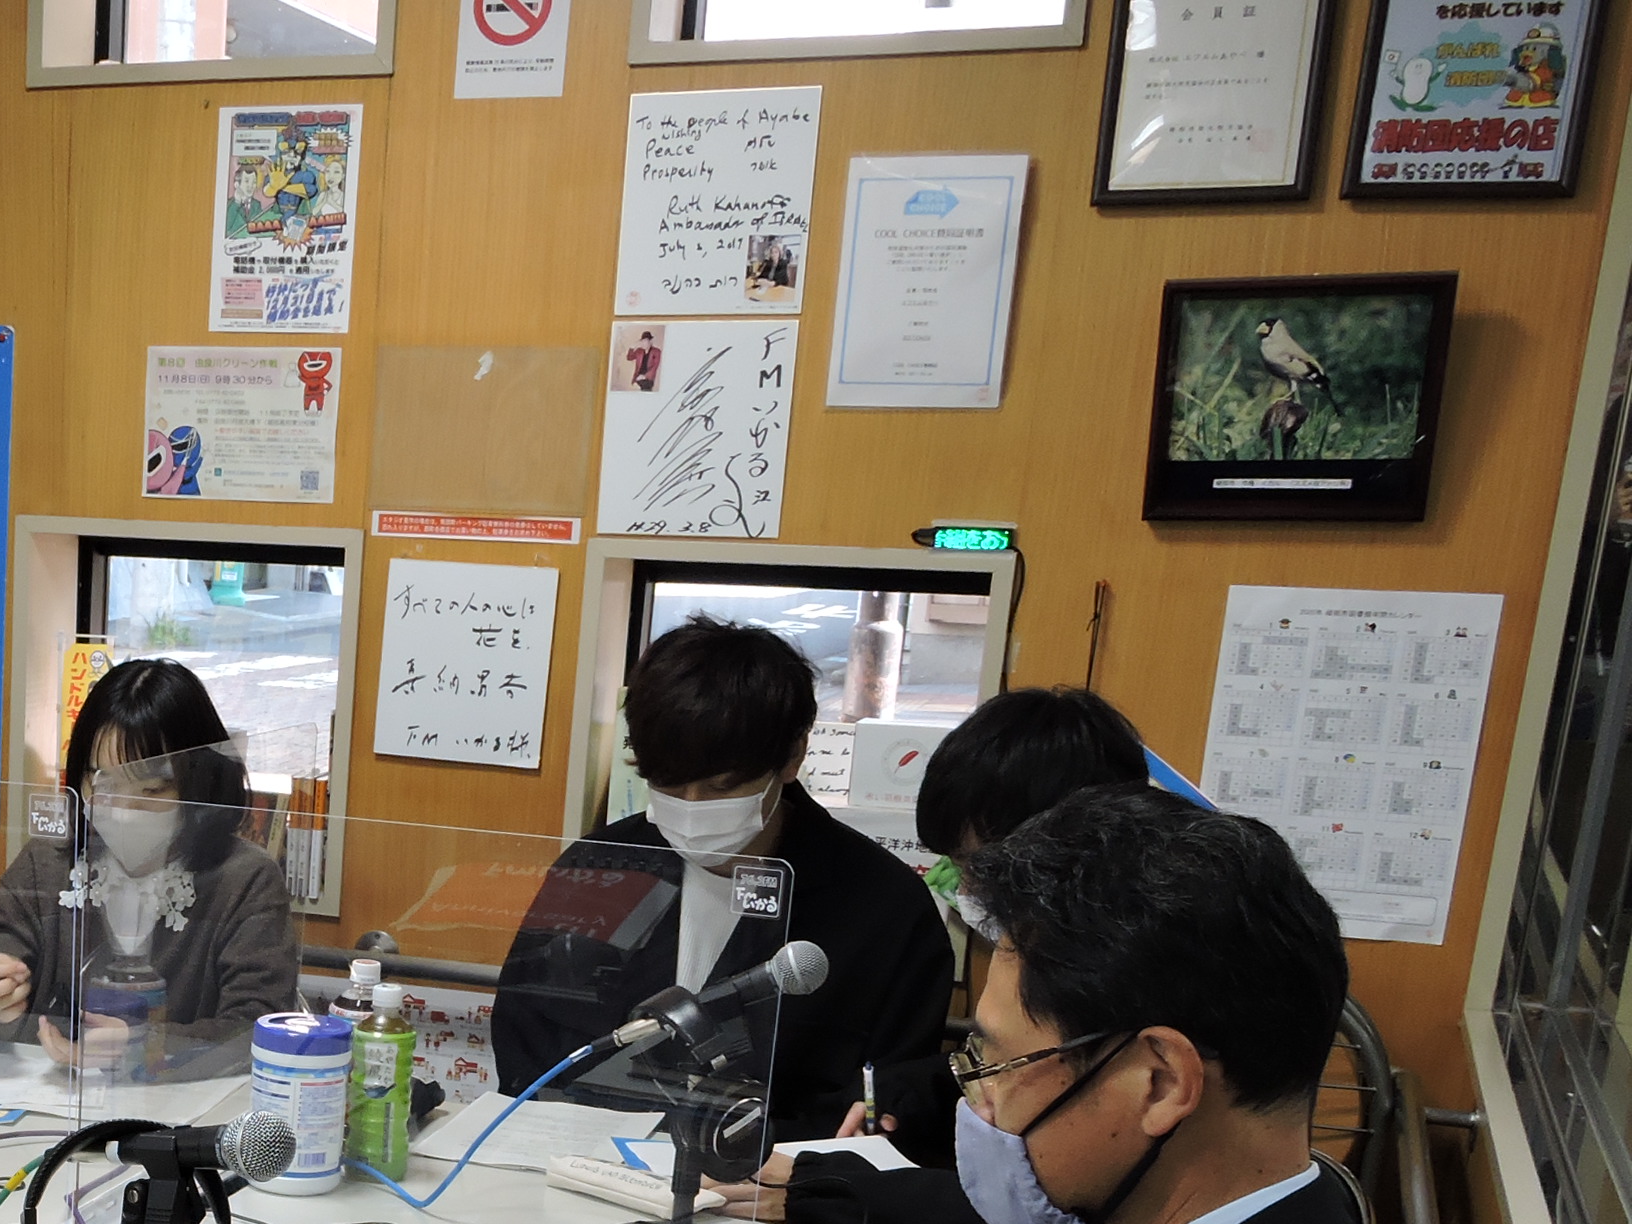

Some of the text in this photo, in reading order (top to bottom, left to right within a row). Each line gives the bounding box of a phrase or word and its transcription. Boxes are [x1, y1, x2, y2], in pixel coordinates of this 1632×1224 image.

[636, 107, 810, 133] To the people of Ayabe
[646, 138, 695, 159] Peace
[643, 161, 714, 183] Prosperity
[667, 195, 702, 218] Ruth
[658, 241, 686, 261] July
